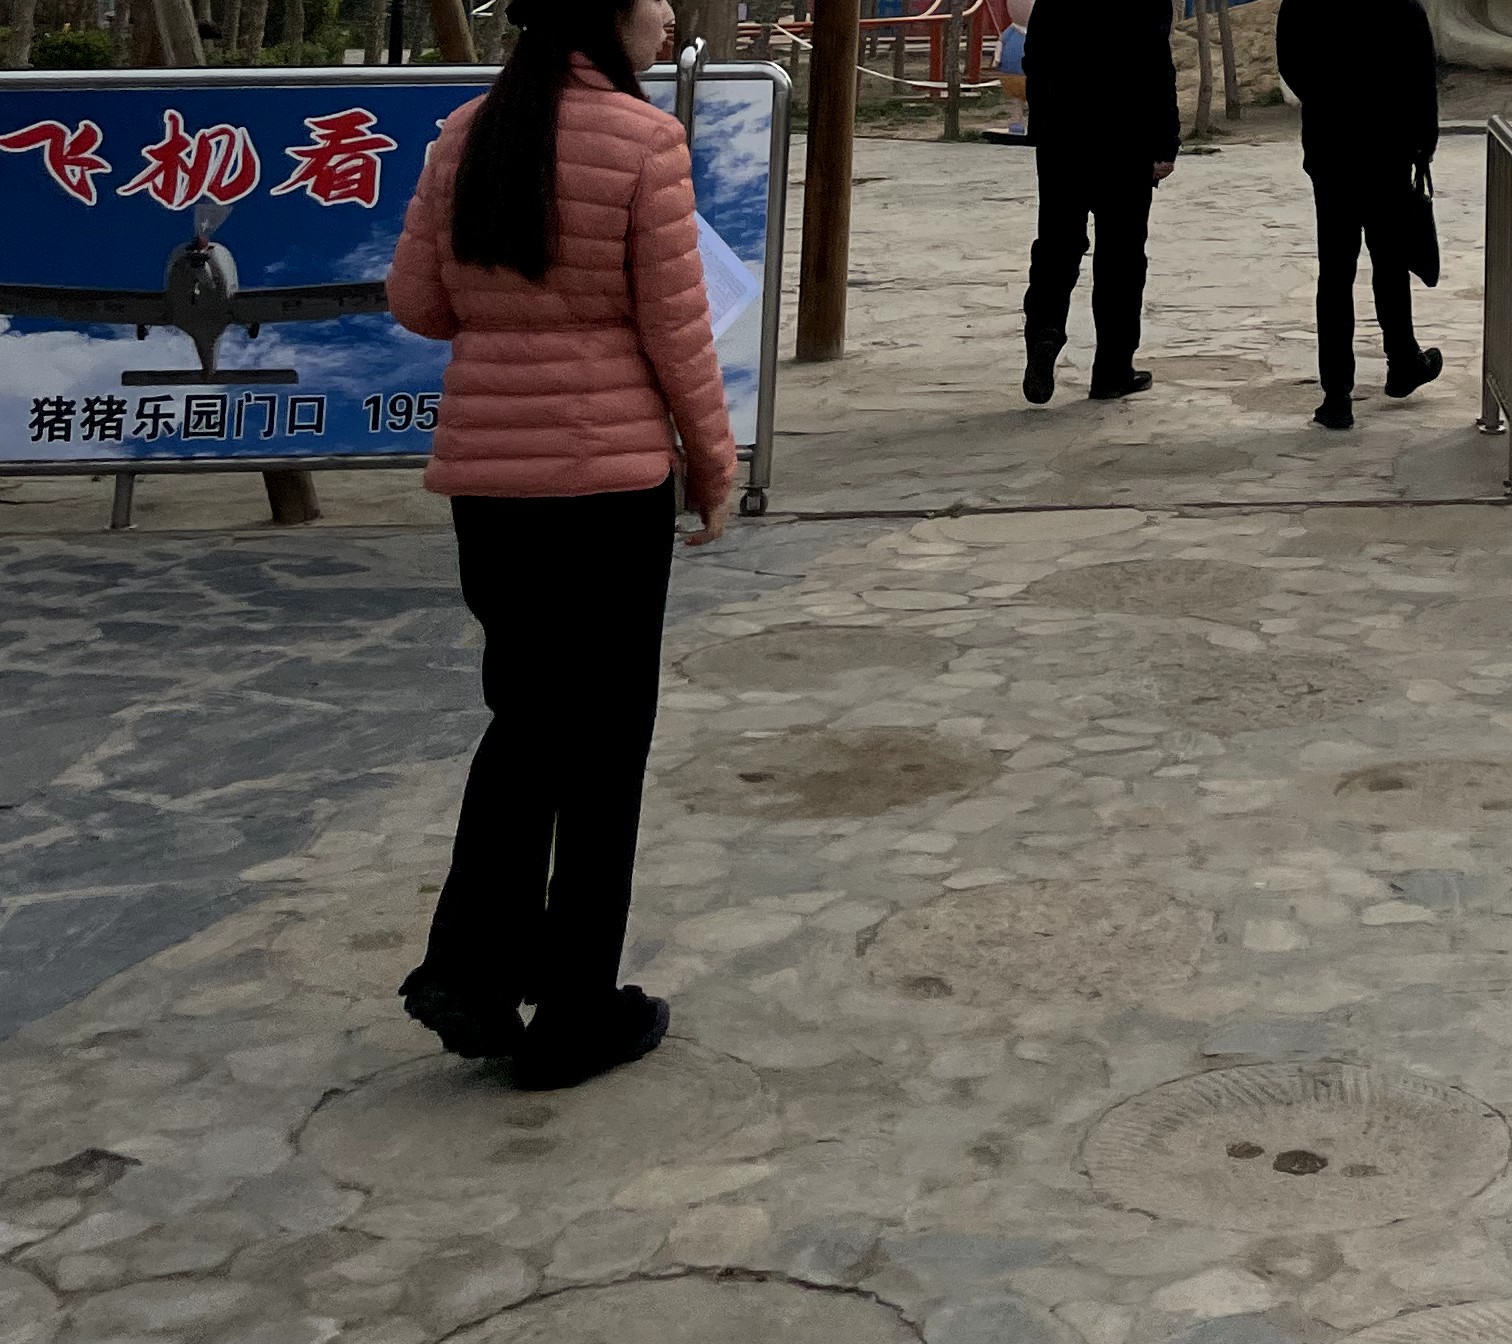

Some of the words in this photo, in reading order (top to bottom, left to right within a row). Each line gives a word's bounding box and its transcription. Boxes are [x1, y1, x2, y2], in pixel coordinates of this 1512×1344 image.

[0, 107, 440, 211] 飞机看
[29, 391, 327, 443] 猪猪乐园门口
